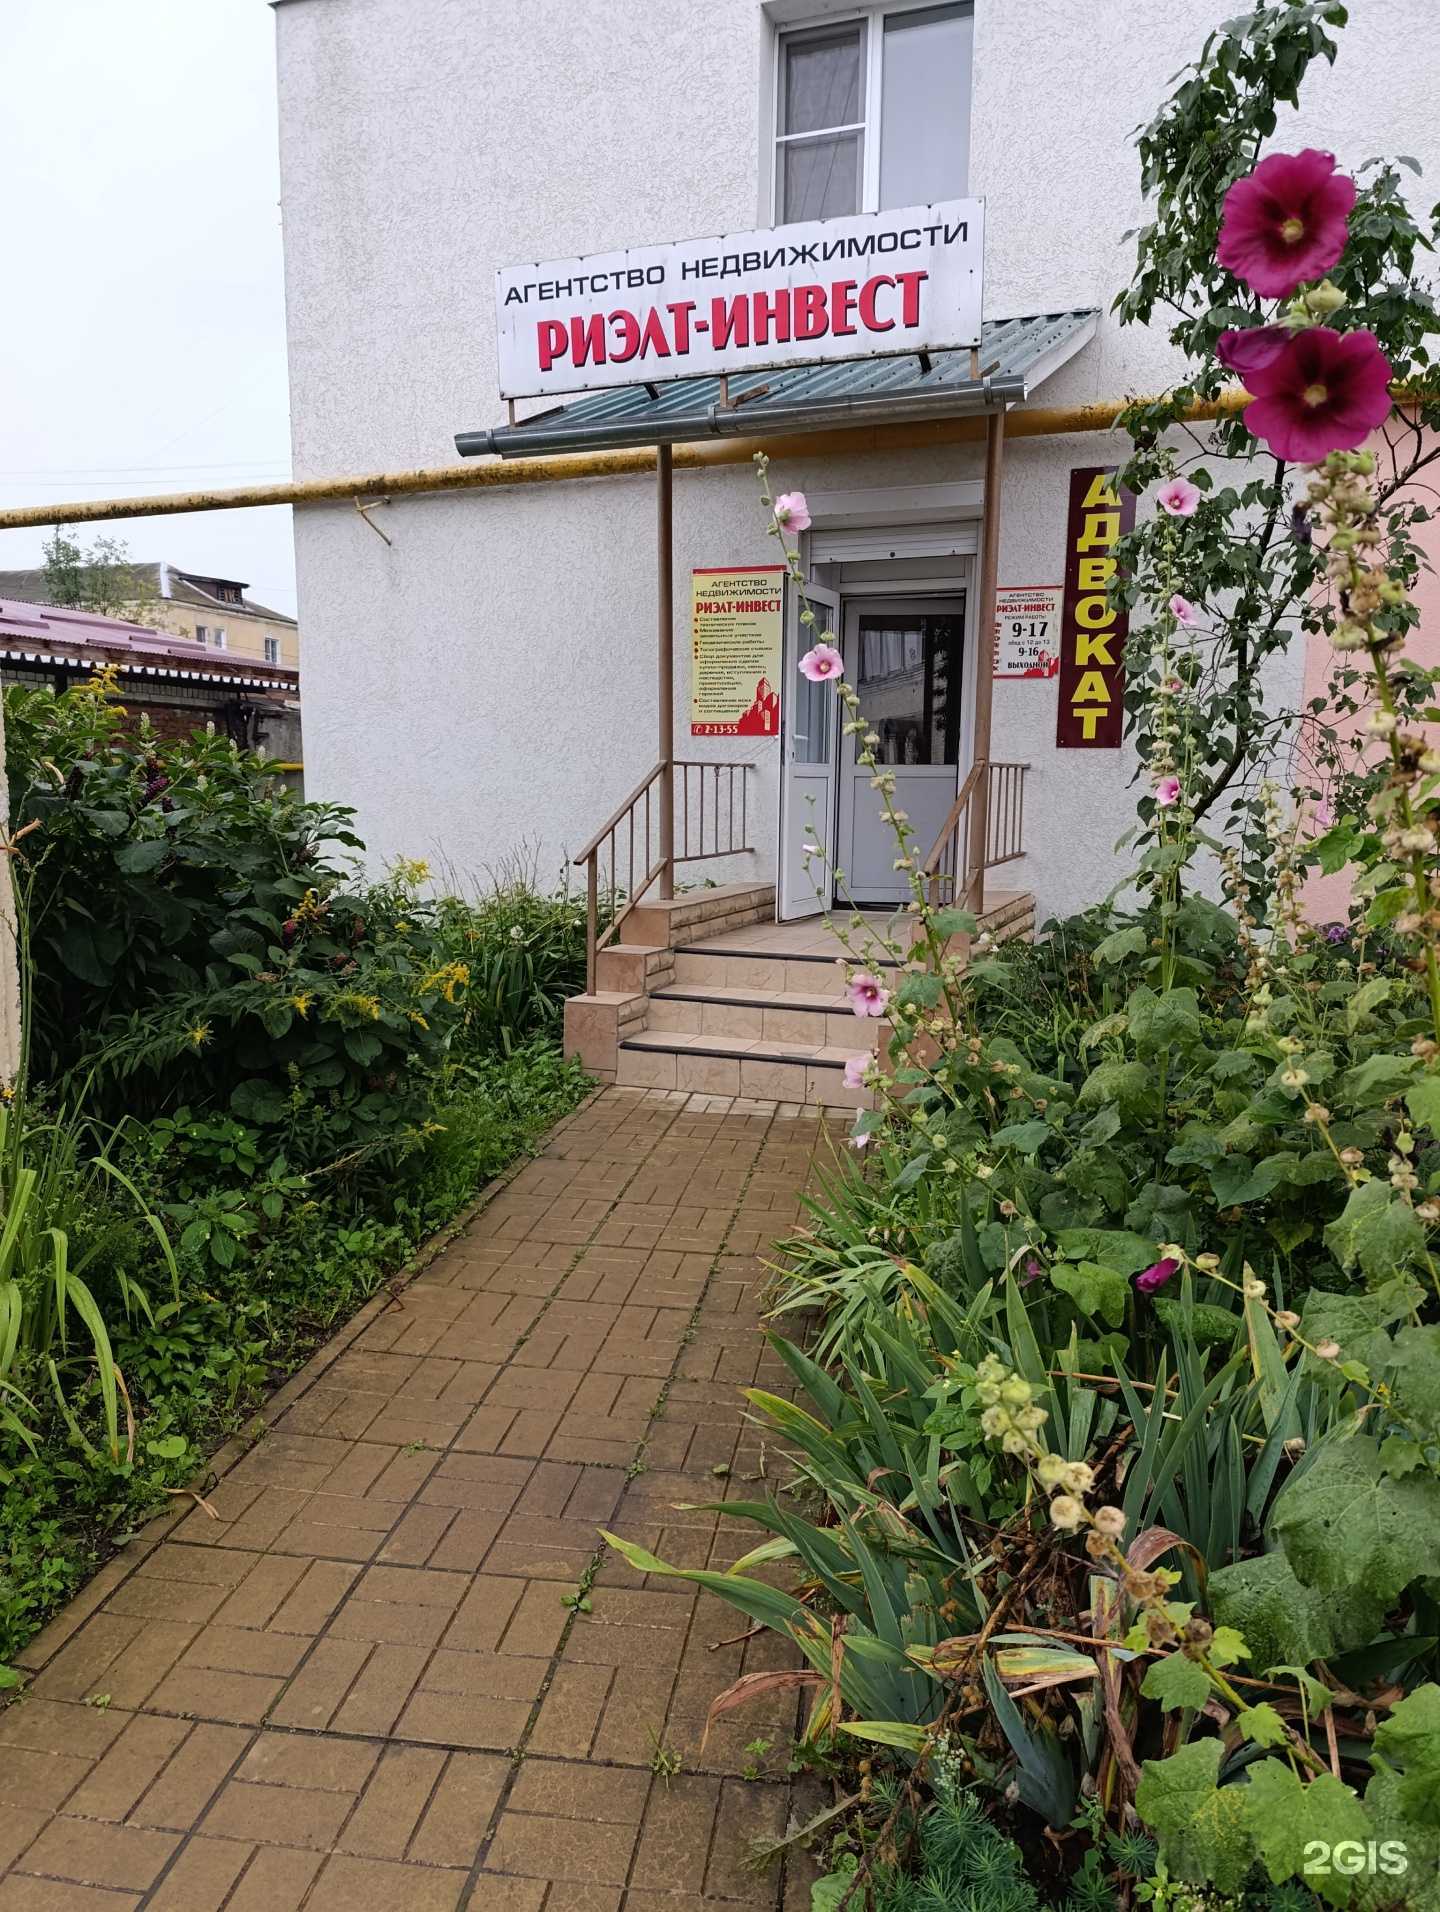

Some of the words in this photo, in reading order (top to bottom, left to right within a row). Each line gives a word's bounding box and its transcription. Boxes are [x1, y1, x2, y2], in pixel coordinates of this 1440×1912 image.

[503, 265, 665, 306] АГЕНТСТВО
[681, 221, 969, 281] НЕДВИЖИМОСТИ
[536, 270, 929, 372] РИЭЛТ-ИНВЕСТ
[711, 579, 768, 588] АГЕНТСТВО
[695, 588, 782, 597] НЕДВИЖИМОСТИ
[695, 600, 782, 614] РИЭЛТ-ИНВЕСТ
[996, 603, 1056, 613] РИЭЛТ-ИНВЕСТ
[1070, 474, 1124, 740] АДВОКАТ
[1011, 621, 1049, 638] 9-17
[1018, 646, 1039, 657] 9-16
[704, 724, 739, 734] 2-13-55
